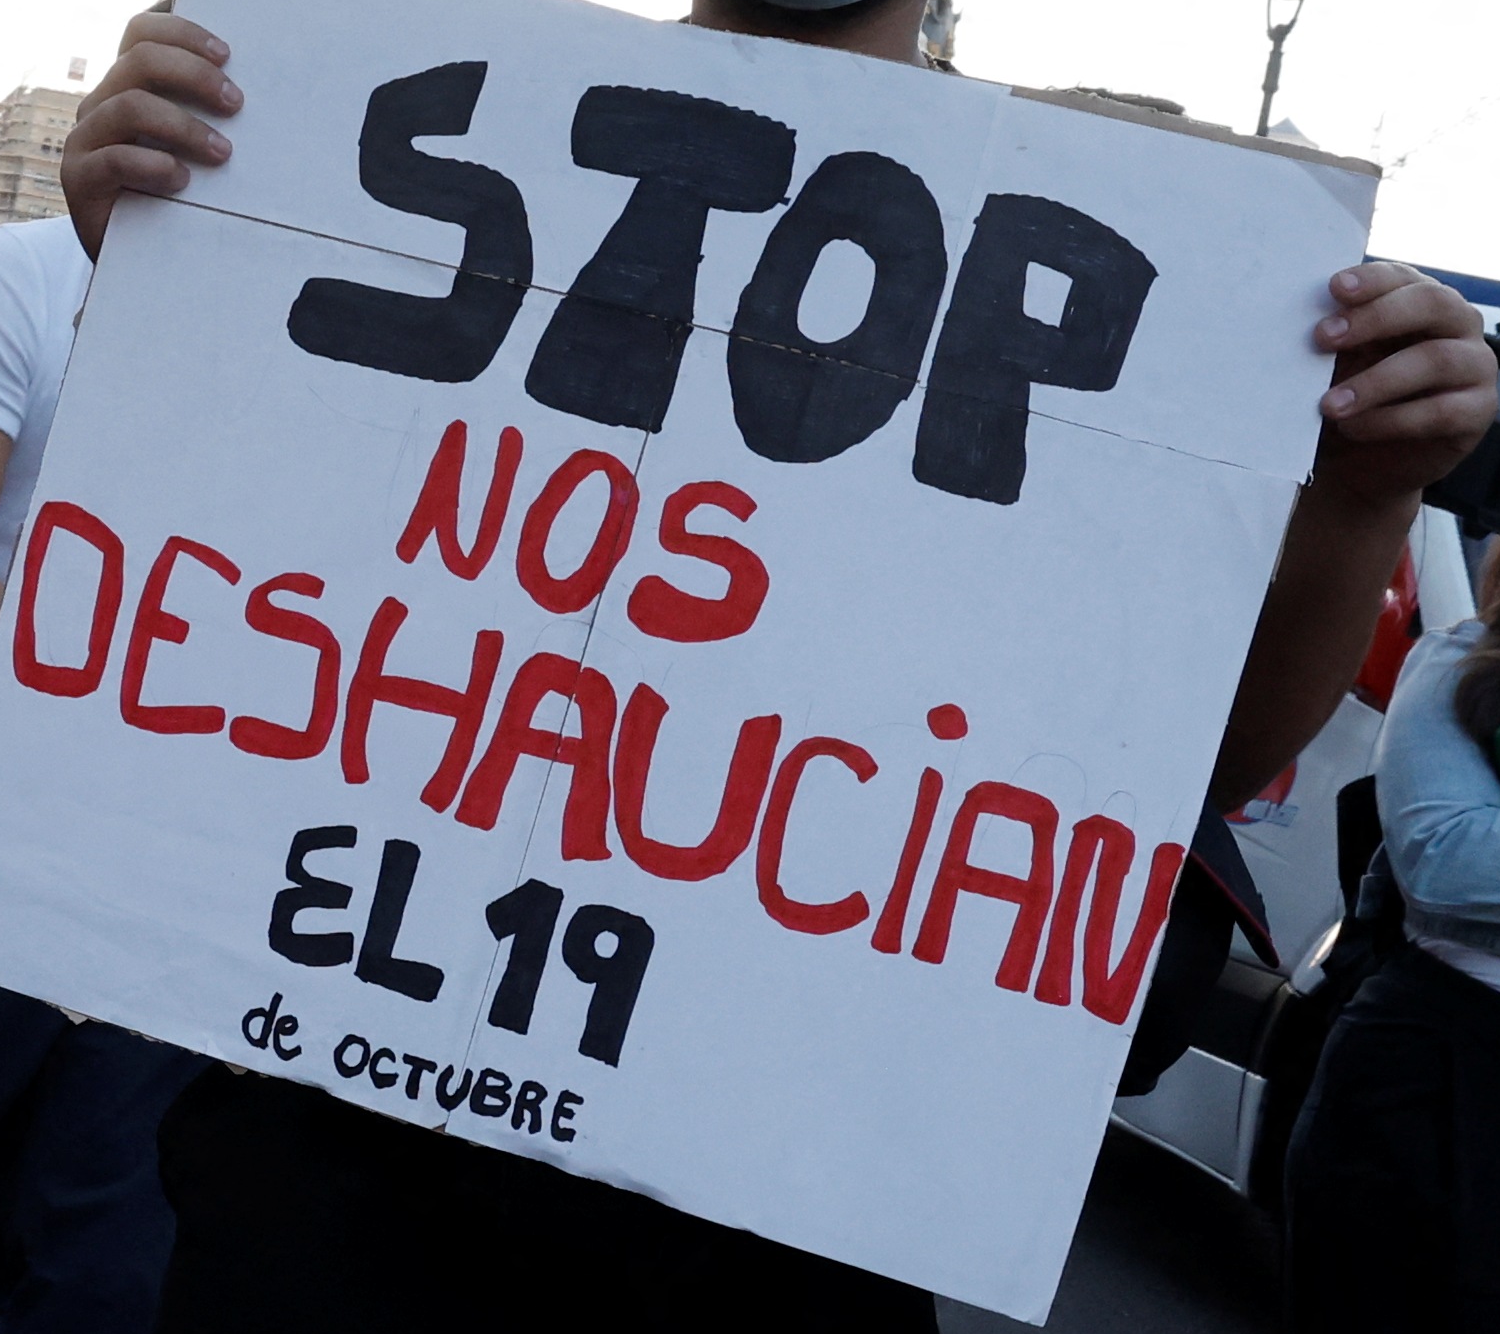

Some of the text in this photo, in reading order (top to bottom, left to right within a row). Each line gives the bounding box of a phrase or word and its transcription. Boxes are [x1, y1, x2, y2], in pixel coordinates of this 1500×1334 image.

[286, 60, 1158, 506] STOP
[395, 418, 770, 643] NOS
[266, 824, 656, 1068] EL 19
[240, 991, 585, 1142] de OCTUBRE
